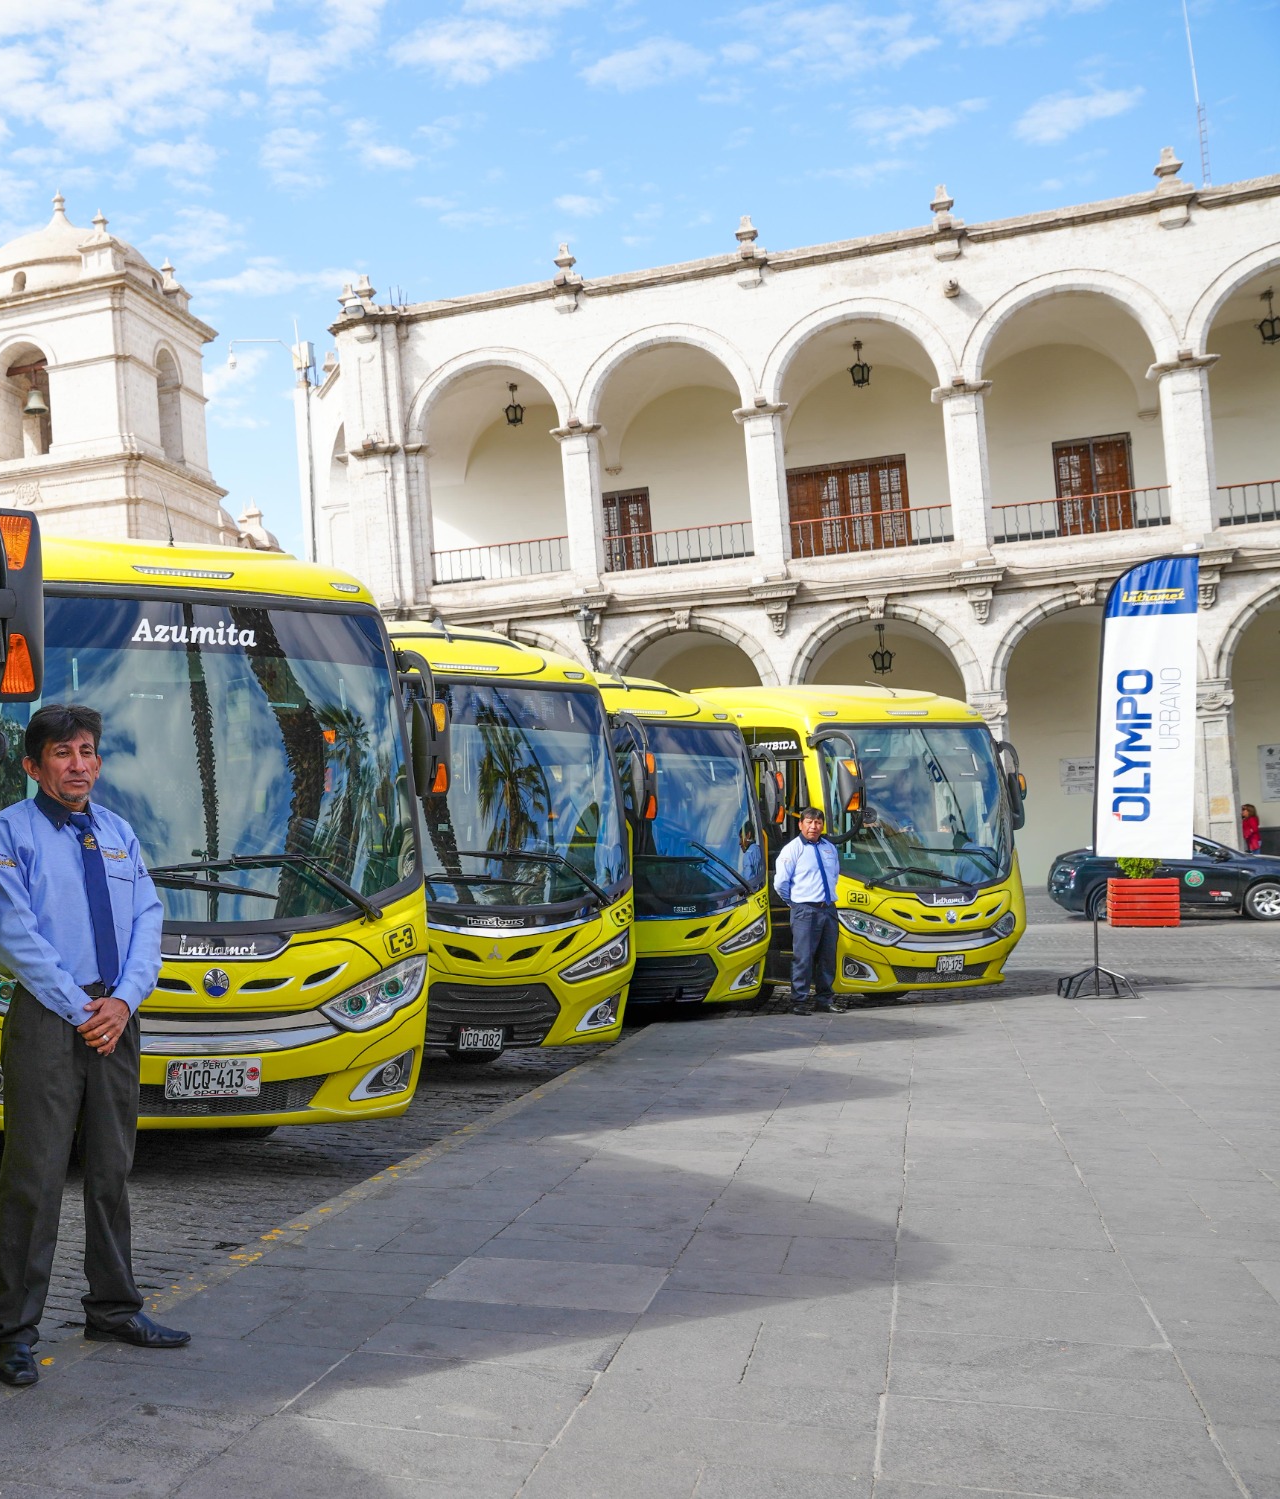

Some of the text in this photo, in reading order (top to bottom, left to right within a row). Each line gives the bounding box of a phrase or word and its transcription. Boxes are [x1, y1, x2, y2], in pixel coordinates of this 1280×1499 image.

[131, 618, 257, 647] Azumita
[1158, 667, 1182, 750] URBANO
[1111, 669, 1153, 821] OLYMPO
[850, 892, 868, 903] 321
[179, 934, 259, 956] Intramet
[389, 927, 414, 954] C-3
[461, 1032, 501, 1047] VCQ-082
[184, 1069, 245, 1090] VCQ-413
